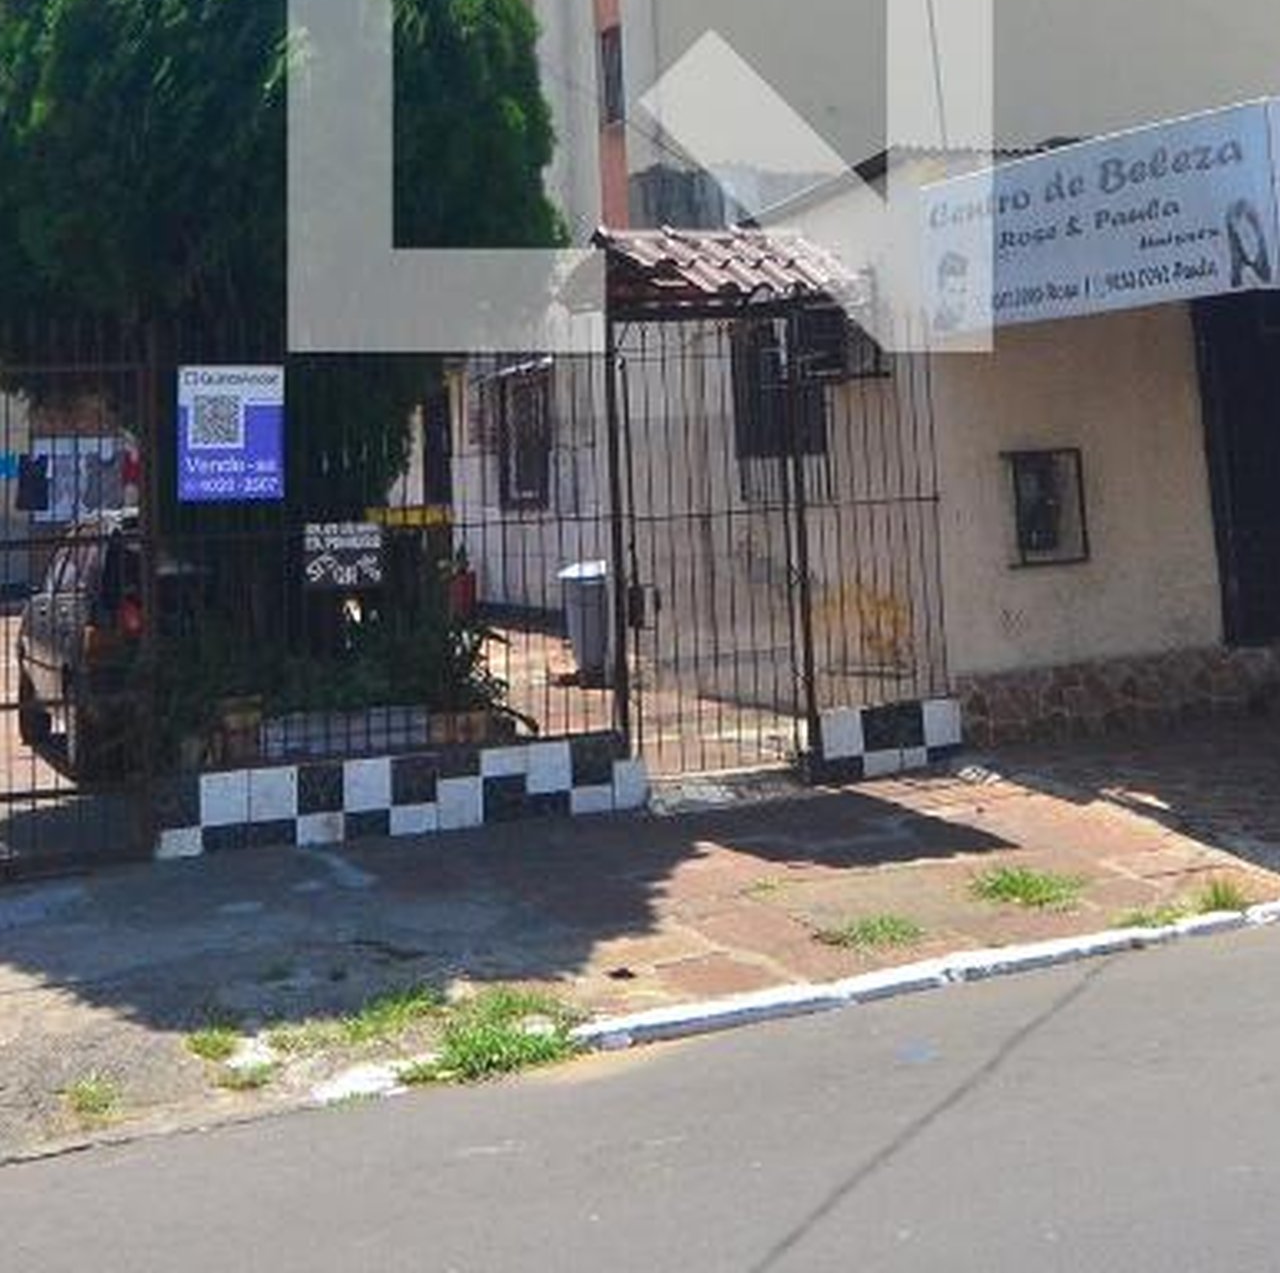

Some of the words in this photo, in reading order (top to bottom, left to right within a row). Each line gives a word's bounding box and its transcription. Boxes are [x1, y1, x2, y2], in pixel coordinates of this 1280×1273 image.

[1043, 169, 1086, 205] de
[1097, 139, 1245, 196] Beleza
[997, 224, 1059, 252] Rose
[1064, 215, 1084, 238] &
[1093, 199, 1181, 231] Paula
